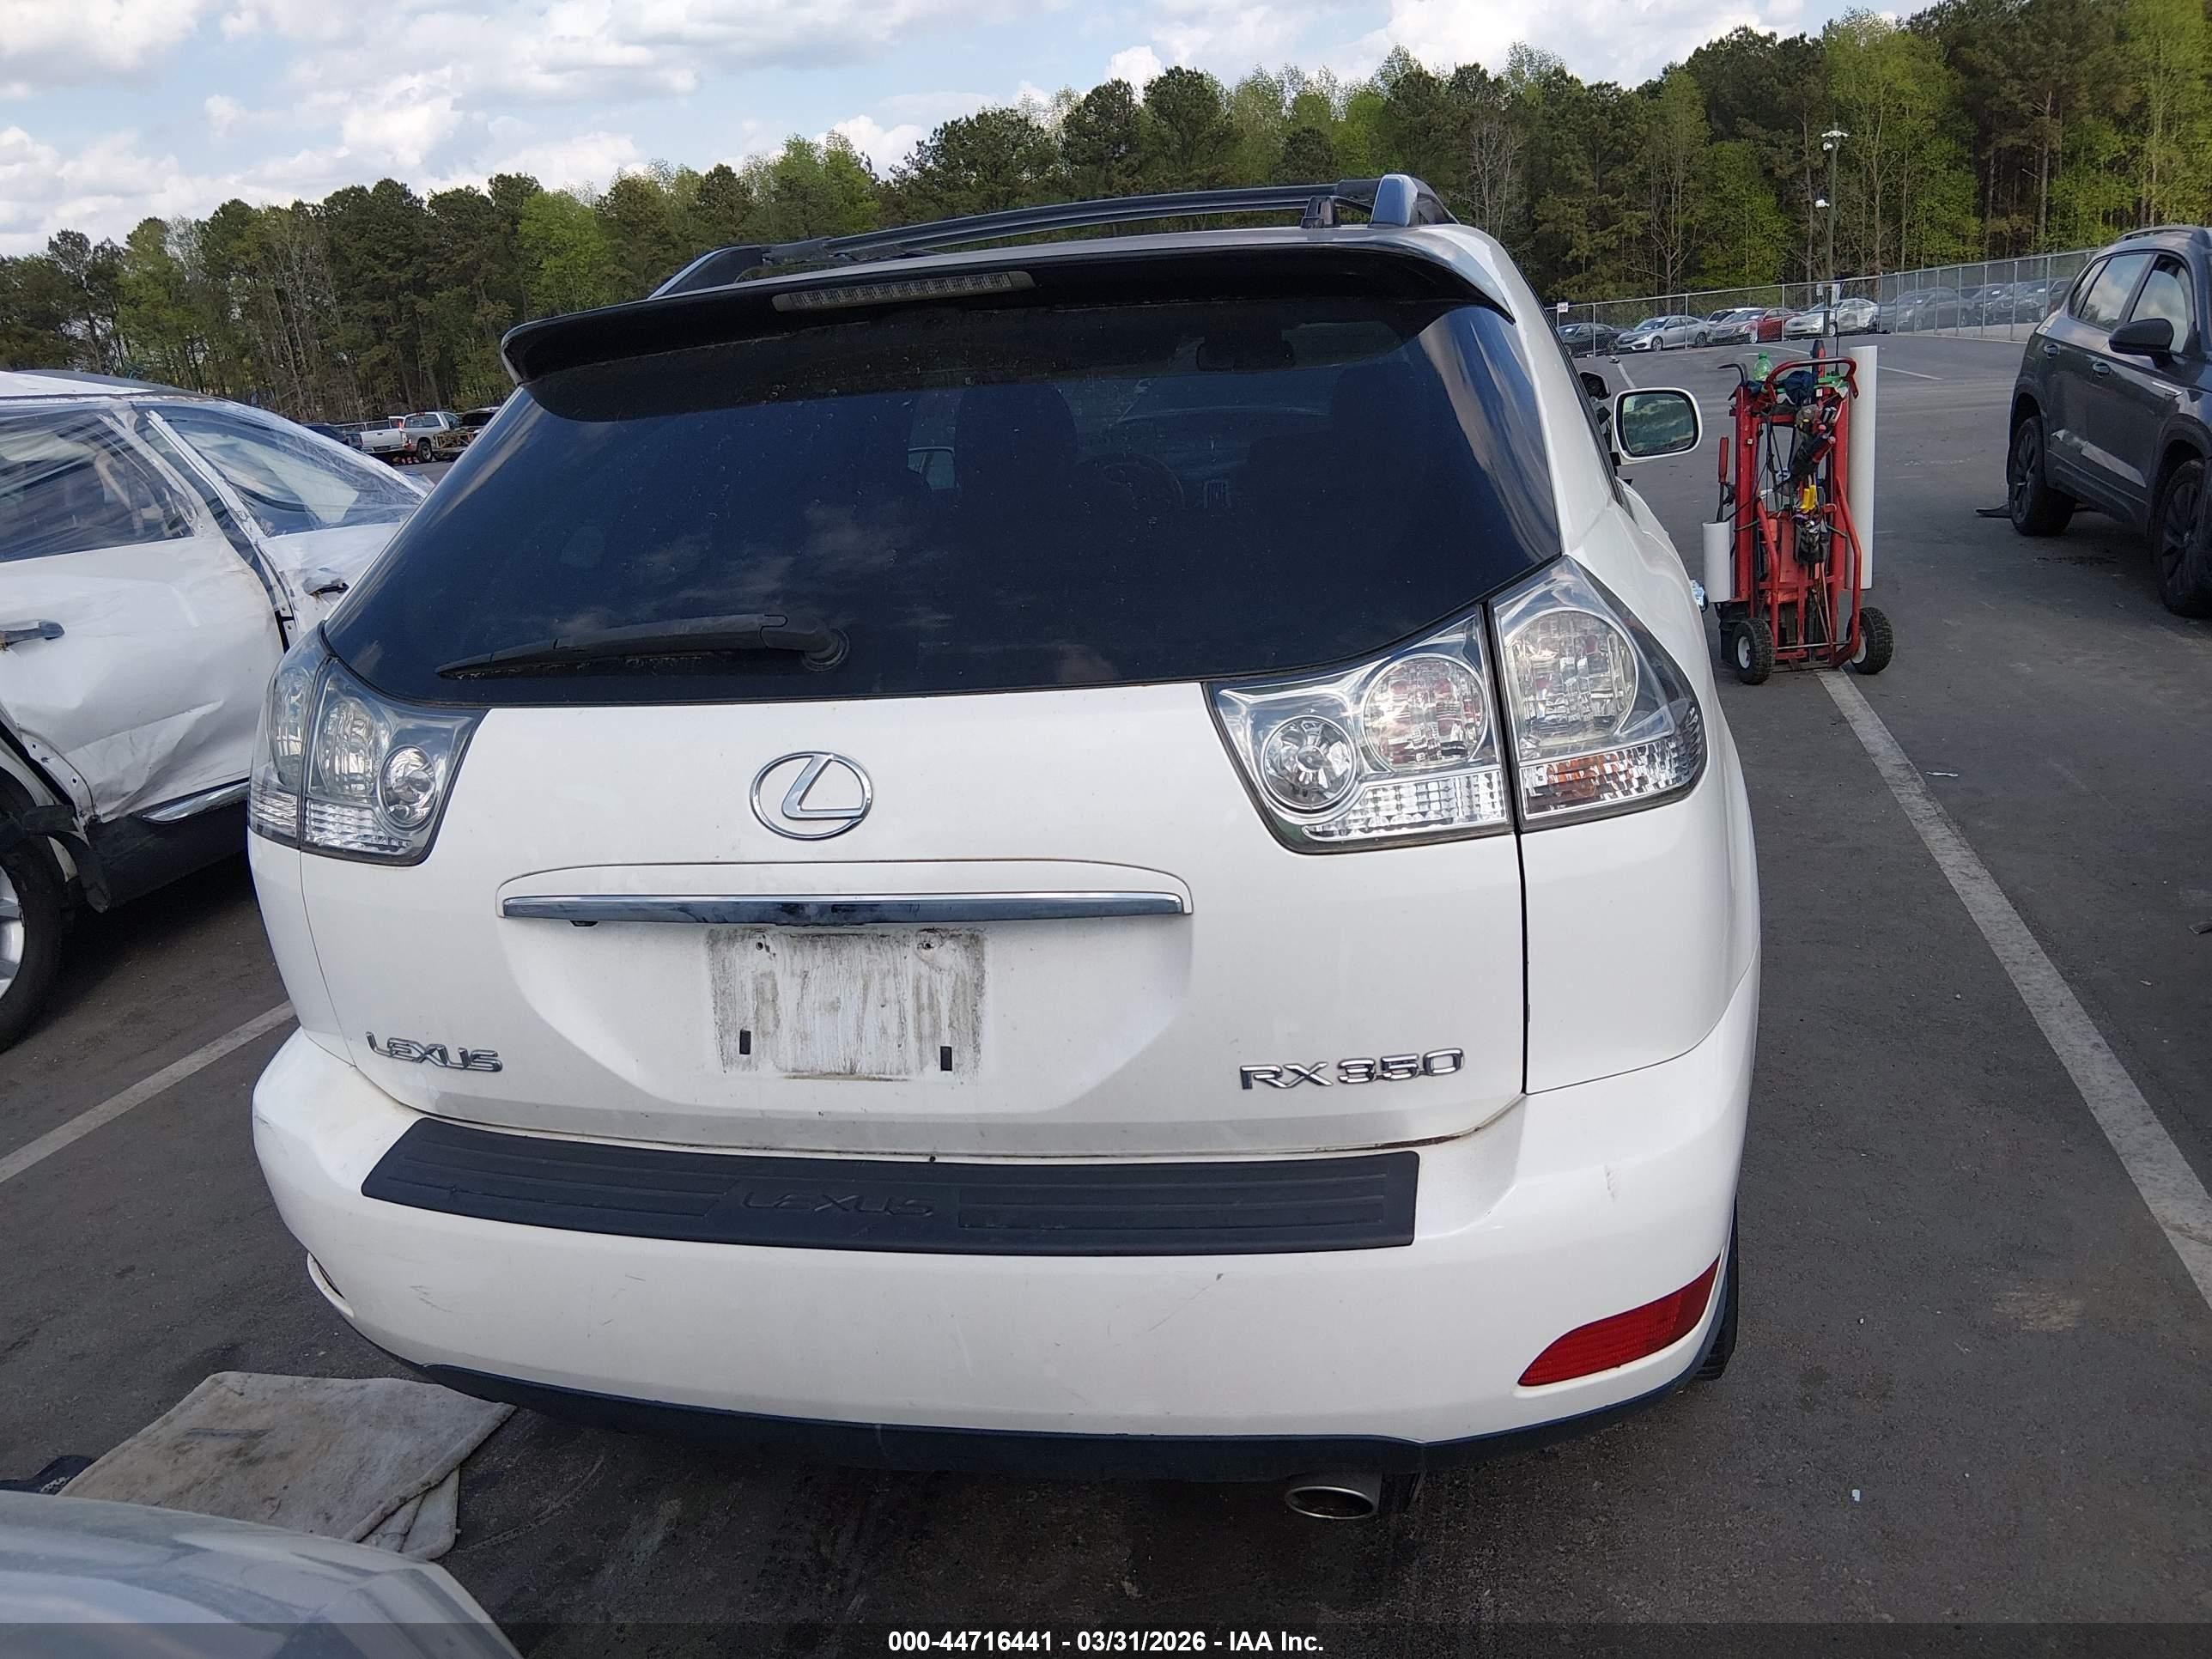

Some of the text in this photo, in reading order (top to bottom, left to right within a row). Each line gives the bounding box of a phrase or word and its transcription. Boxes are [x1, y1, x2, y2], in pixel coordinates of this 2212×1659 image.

[366, 1031, 503, 1073] LEXUS
[1240, 1048, 1464, 1091] RX 350
[742, 1192, 935, 1216] LEXUS
